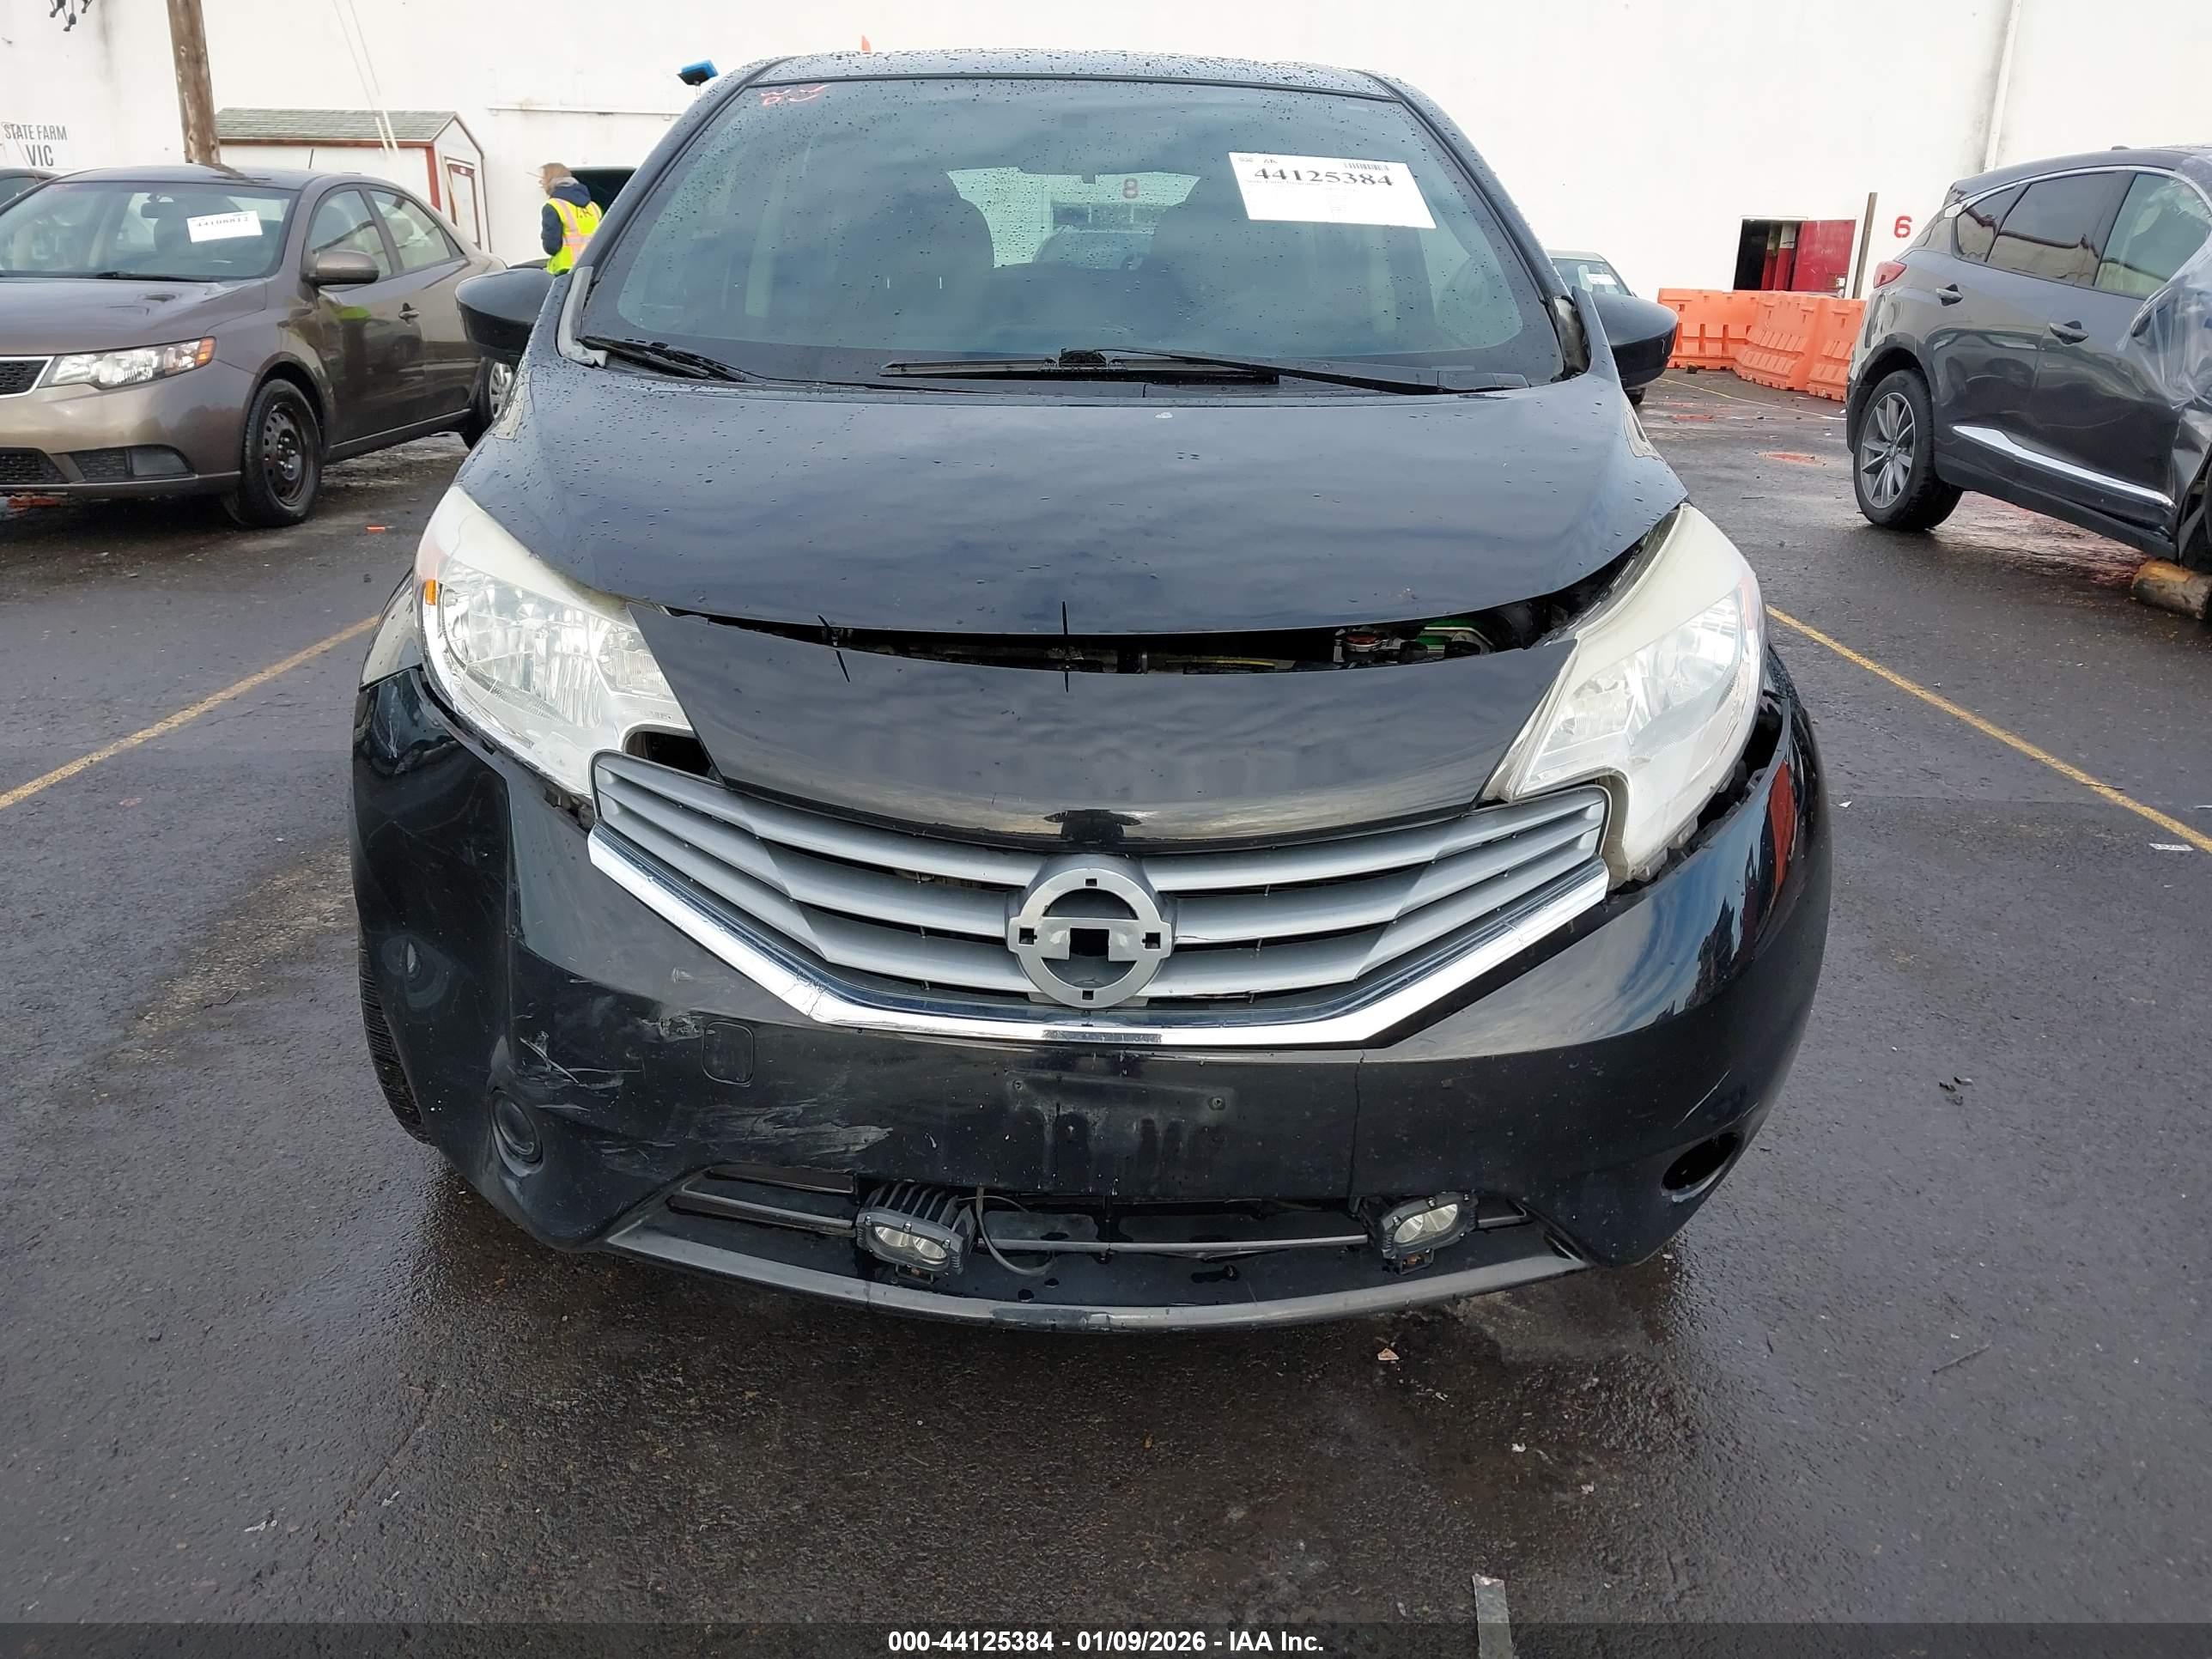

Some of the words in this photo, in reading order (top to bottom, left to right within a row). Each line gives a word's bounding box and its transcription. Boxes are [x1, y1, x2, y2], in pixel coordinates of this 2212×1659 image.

[3, 124, 35, 140] STATE
[36, 125, 68, 141] FARM
[26, 144, 54, 167] VIC
[1255, 167, 1394, 186] 44125384
[1121, 178, 1139, 199] 8
[1894, 216, 1912, 238] 6
